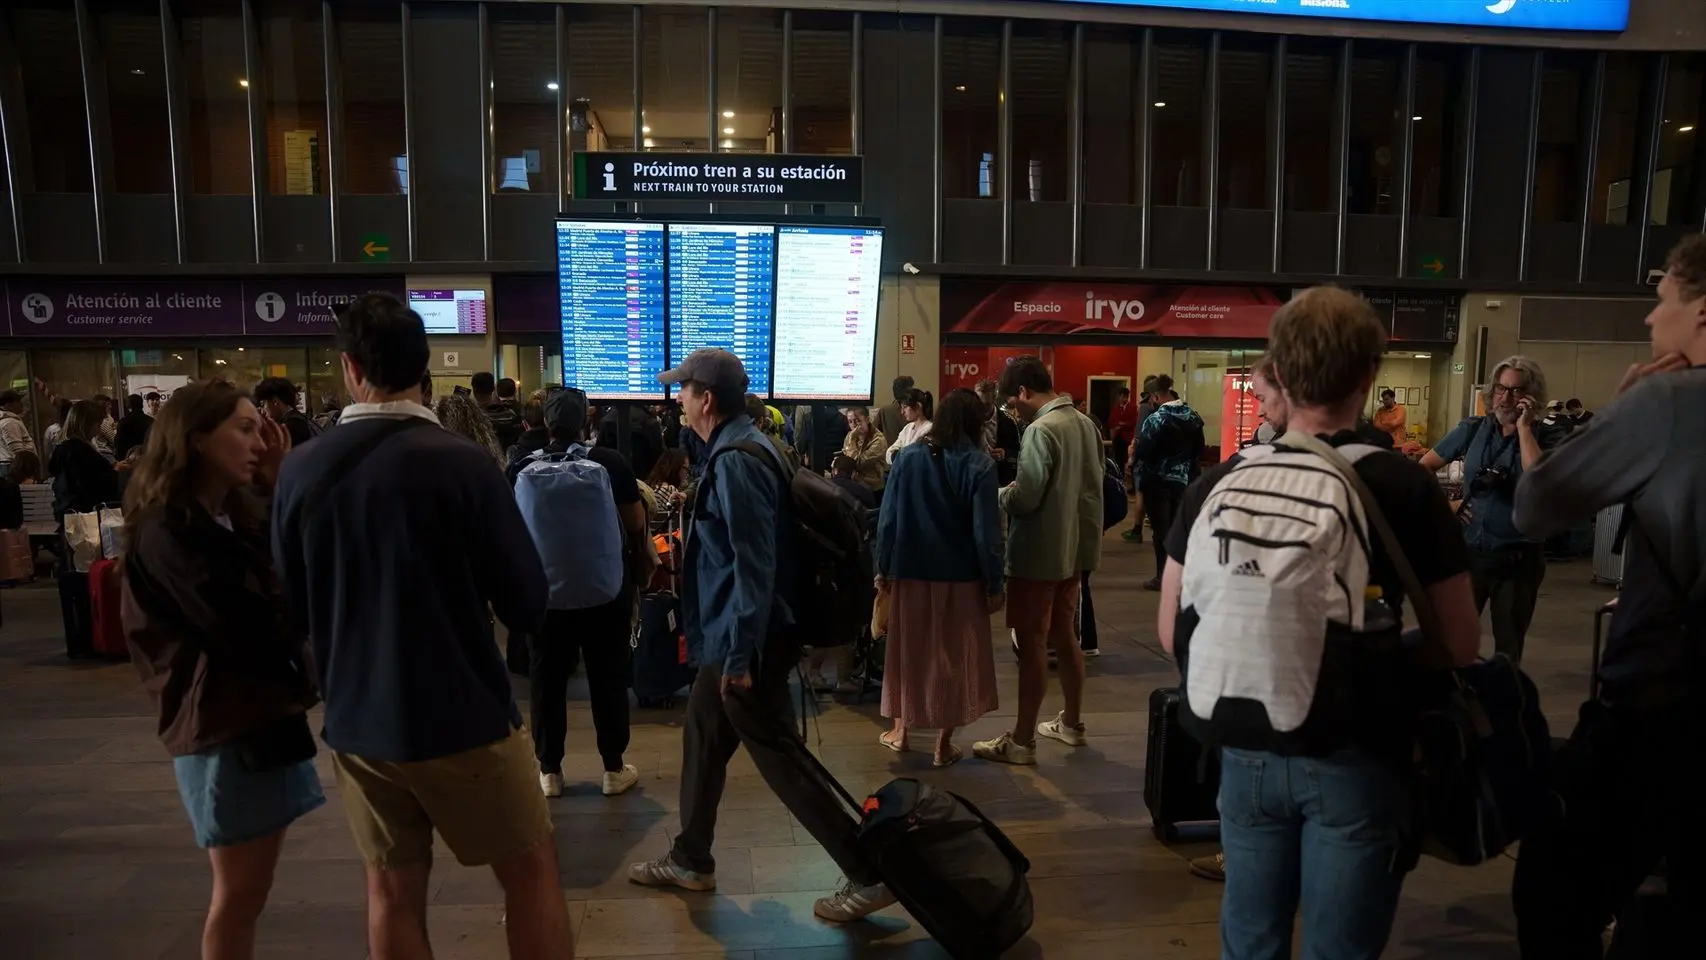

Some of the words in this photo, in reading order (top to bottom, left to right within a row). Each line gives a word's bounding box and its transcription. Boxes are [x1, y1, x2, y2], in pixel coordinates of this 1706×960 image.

[633, 162, 698, 177] Próximo
[704, 164, 737, 178] tren
[743, 167, 751, 179] a
[757, 167, 775, 179] su
[780, 164, 846, 180] estación
[633, 182, 661, 192] NEXT
[662, 183, 694, 193] TRAIN
[696, 183, 709, 193] TO
[711, 183, 739, 193] YOUR
[741, 184, 784, 194] STATION
[66, 293, 139, 308] Atención
[145, 293, 160, 308] al
[166, 293, 222, 308] cliente
[296, 291, 358, 306] Informa
[1014, 301, 1061, 316] Espacio
[1086, 290, 1145, 329] iryo
[67, 313, 115, 324] Customer
[117, 313, 153, 324] service
[944, 359, 979, 380] iryo
